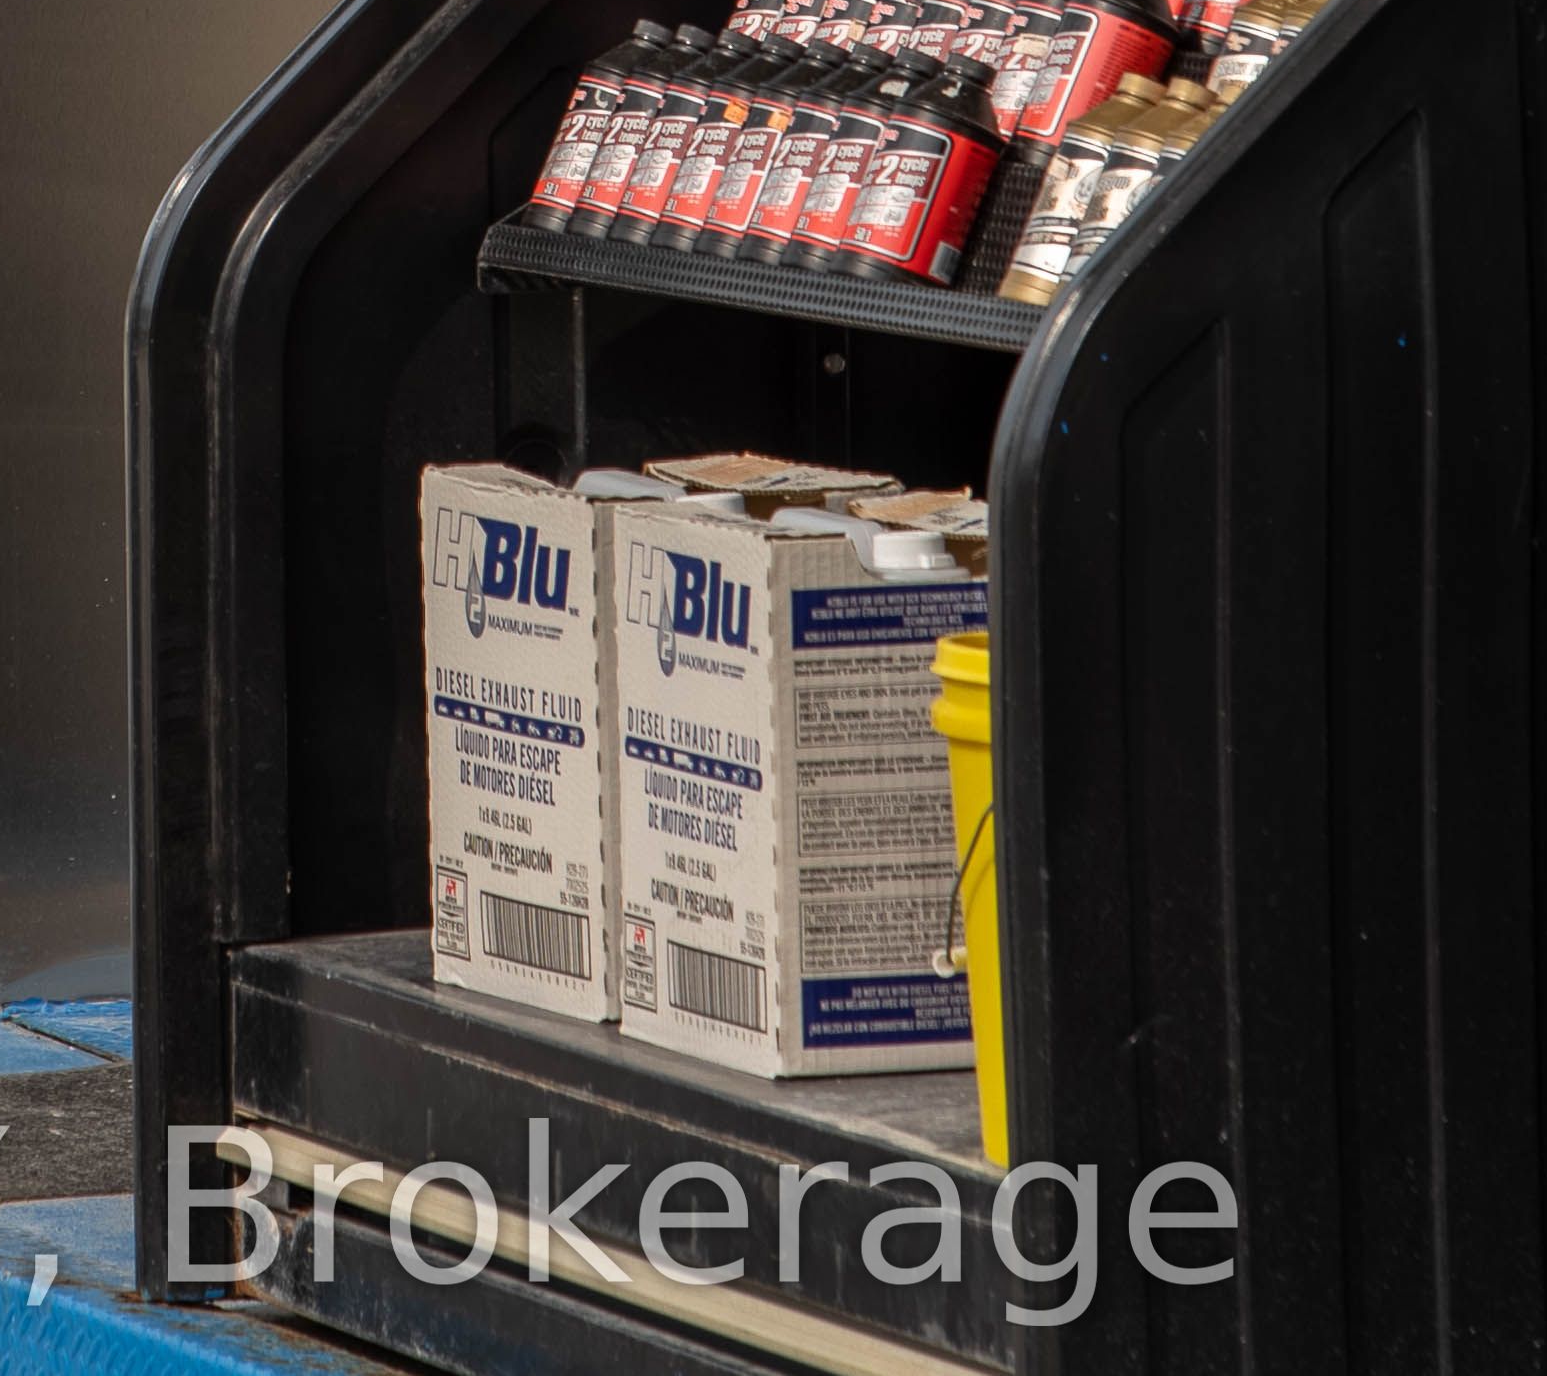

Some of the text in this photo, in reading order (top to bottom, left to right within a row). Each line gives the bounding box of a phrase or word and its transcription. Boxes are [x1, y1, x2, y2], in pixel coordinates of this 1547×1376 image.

[605, 116, 624, 145] 2
[687, 128, 705, 157] 2
[818, 144, 838, 173] 2
[875, 155, 900, 185] 2
[488, 614, 533, 638] MAXIMUM
[679, 651, 720, 675] MAXIMUM
[436, 666, 582, 723] DIESEL EXHAUST FLUID
[456, 723, 561, 776] LÍQUIDO PARA ESCAPE
[627, 706, 761, 765] DIESEL EXHAUST FLUID
[460, 759, 555, 807] DE MOTORES DIÉSEL
[680, 779, 704, 809] PARA
[707, 787, 743, 819] ESCAPE
[648, 802, 737, 852] DE MOTORES DIÉSEL
[464, 831, 493, 860] CAUTION
[499, 842, 553, 875] PRECAUCIÓN
[651, 878, 679, 907] CAUTION
[685, 889, 734, 923] PRECAUCIÓN
